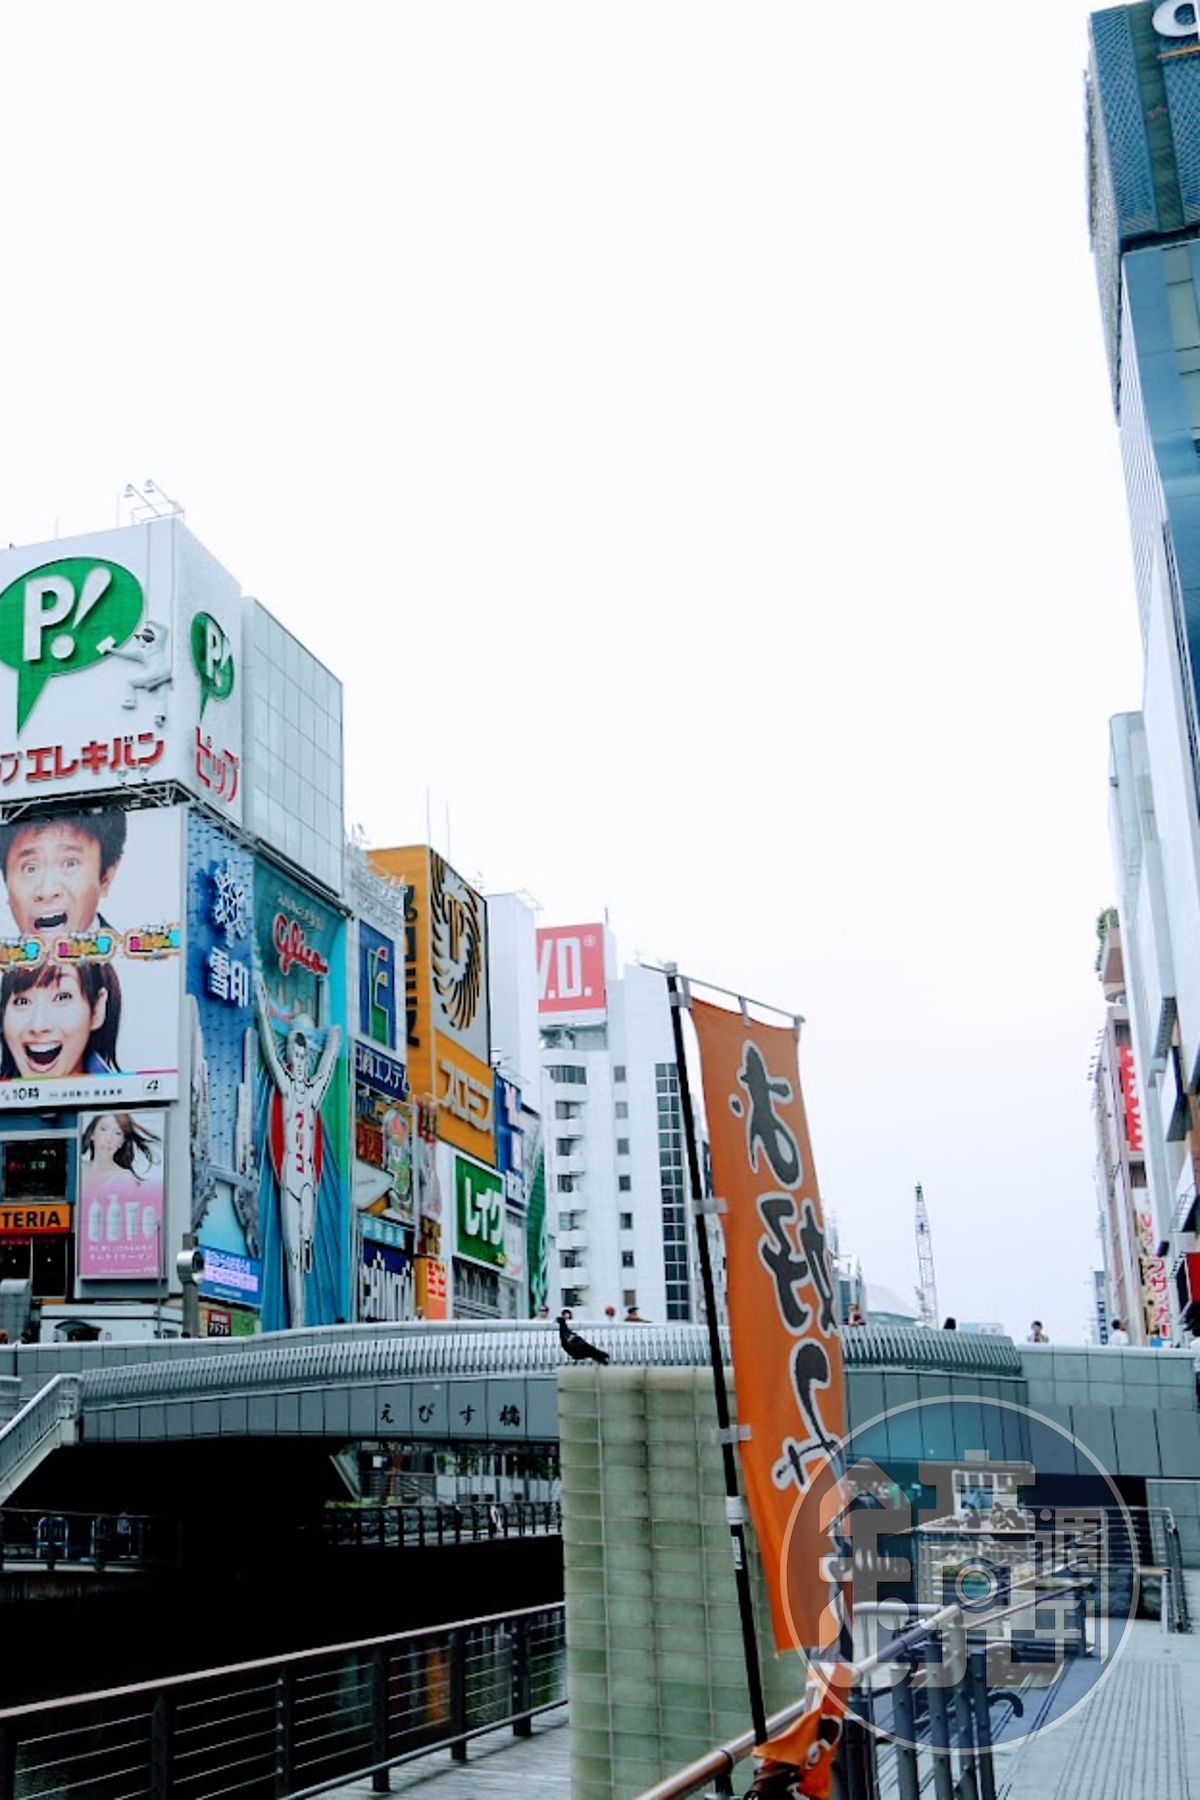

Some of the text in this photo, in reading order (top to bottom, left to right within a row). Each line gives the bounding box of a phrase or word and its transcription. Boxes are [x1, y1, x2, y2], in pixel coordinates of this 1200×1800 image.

[195, 725, 240, 803] ピップ
[273, 912, 329, 976] Glico
[209, 946, 249, 1008] 雪印
